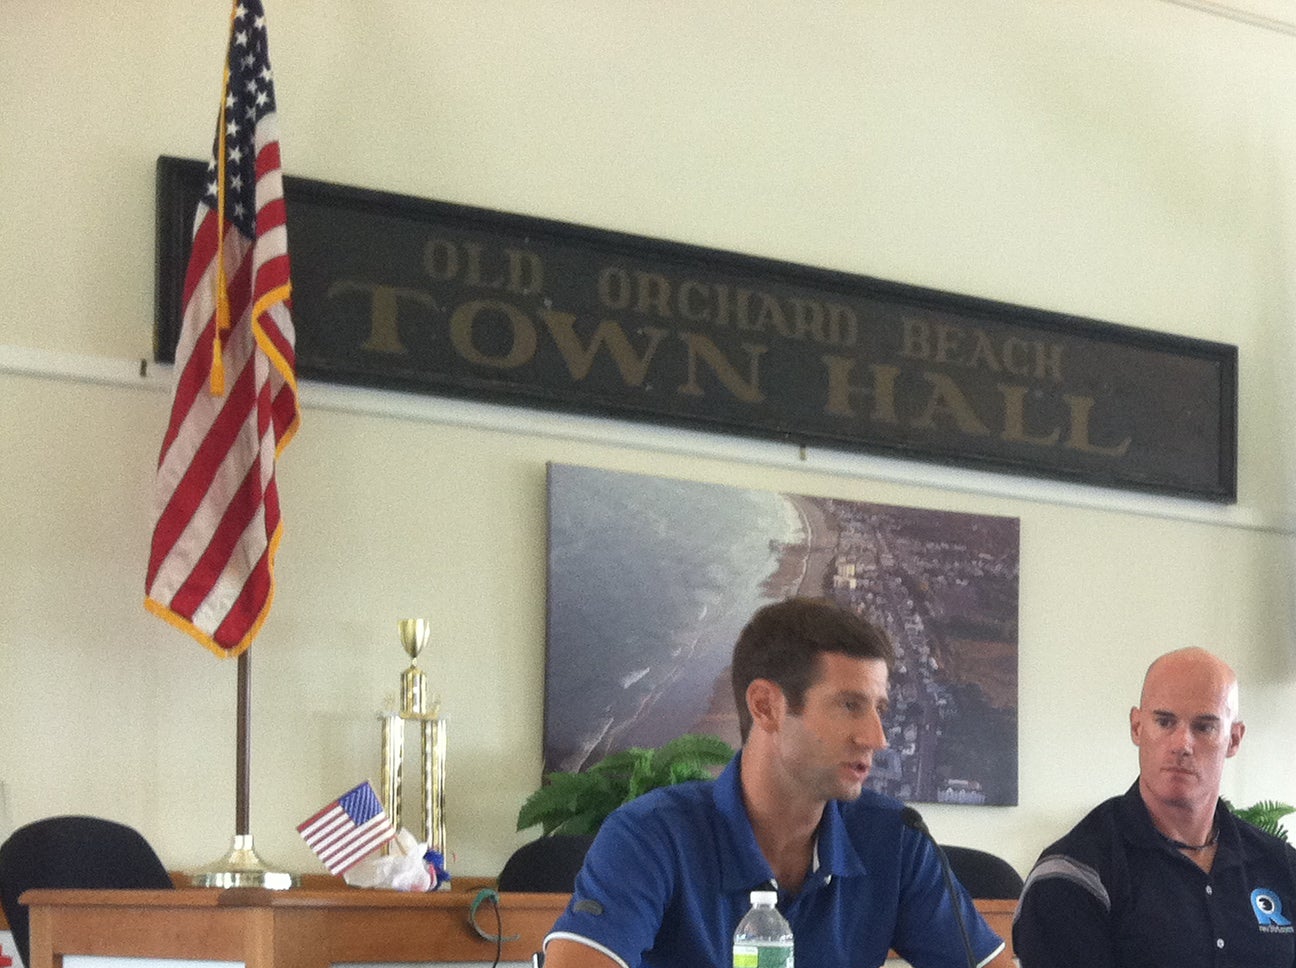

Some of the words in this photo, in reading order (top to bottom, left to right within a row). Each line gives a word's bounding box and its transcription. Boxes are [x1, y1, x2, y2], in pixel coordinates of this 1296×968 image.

[327, 278, 769, 400] TOWN
[822, 355, 1132, 456] HALL
[421, 236, 545, 292] OLD
[600, 266, 857, 345] ORCHARD
[903, 317, 1065, 382] BEACH
